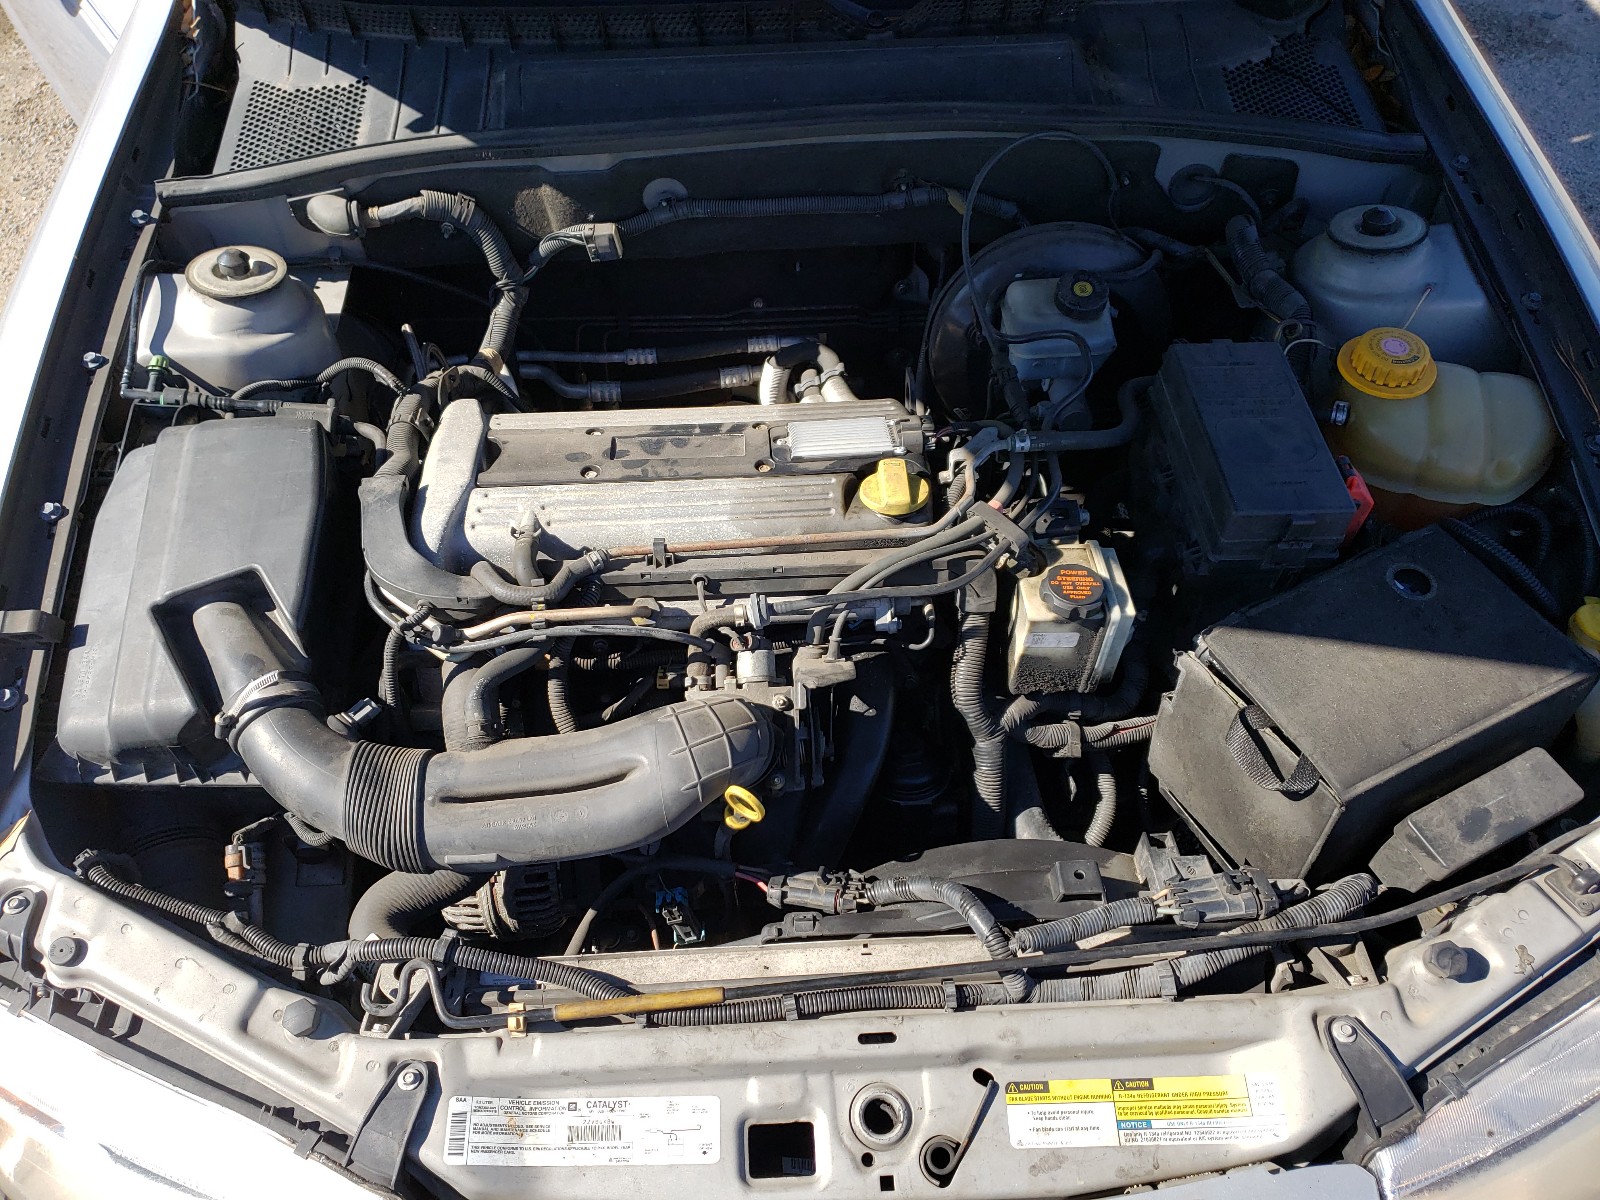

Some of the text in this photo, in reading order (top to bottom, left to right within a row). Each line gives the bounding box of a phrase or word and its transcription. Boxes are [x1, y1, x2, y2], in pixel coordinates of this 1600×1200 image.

[1020, 1083, 1044, 1091] CAUTION
[1126, 1080, 1149, 1088] CAUTION
[586, 1100, 628, 1109] CATALYST
